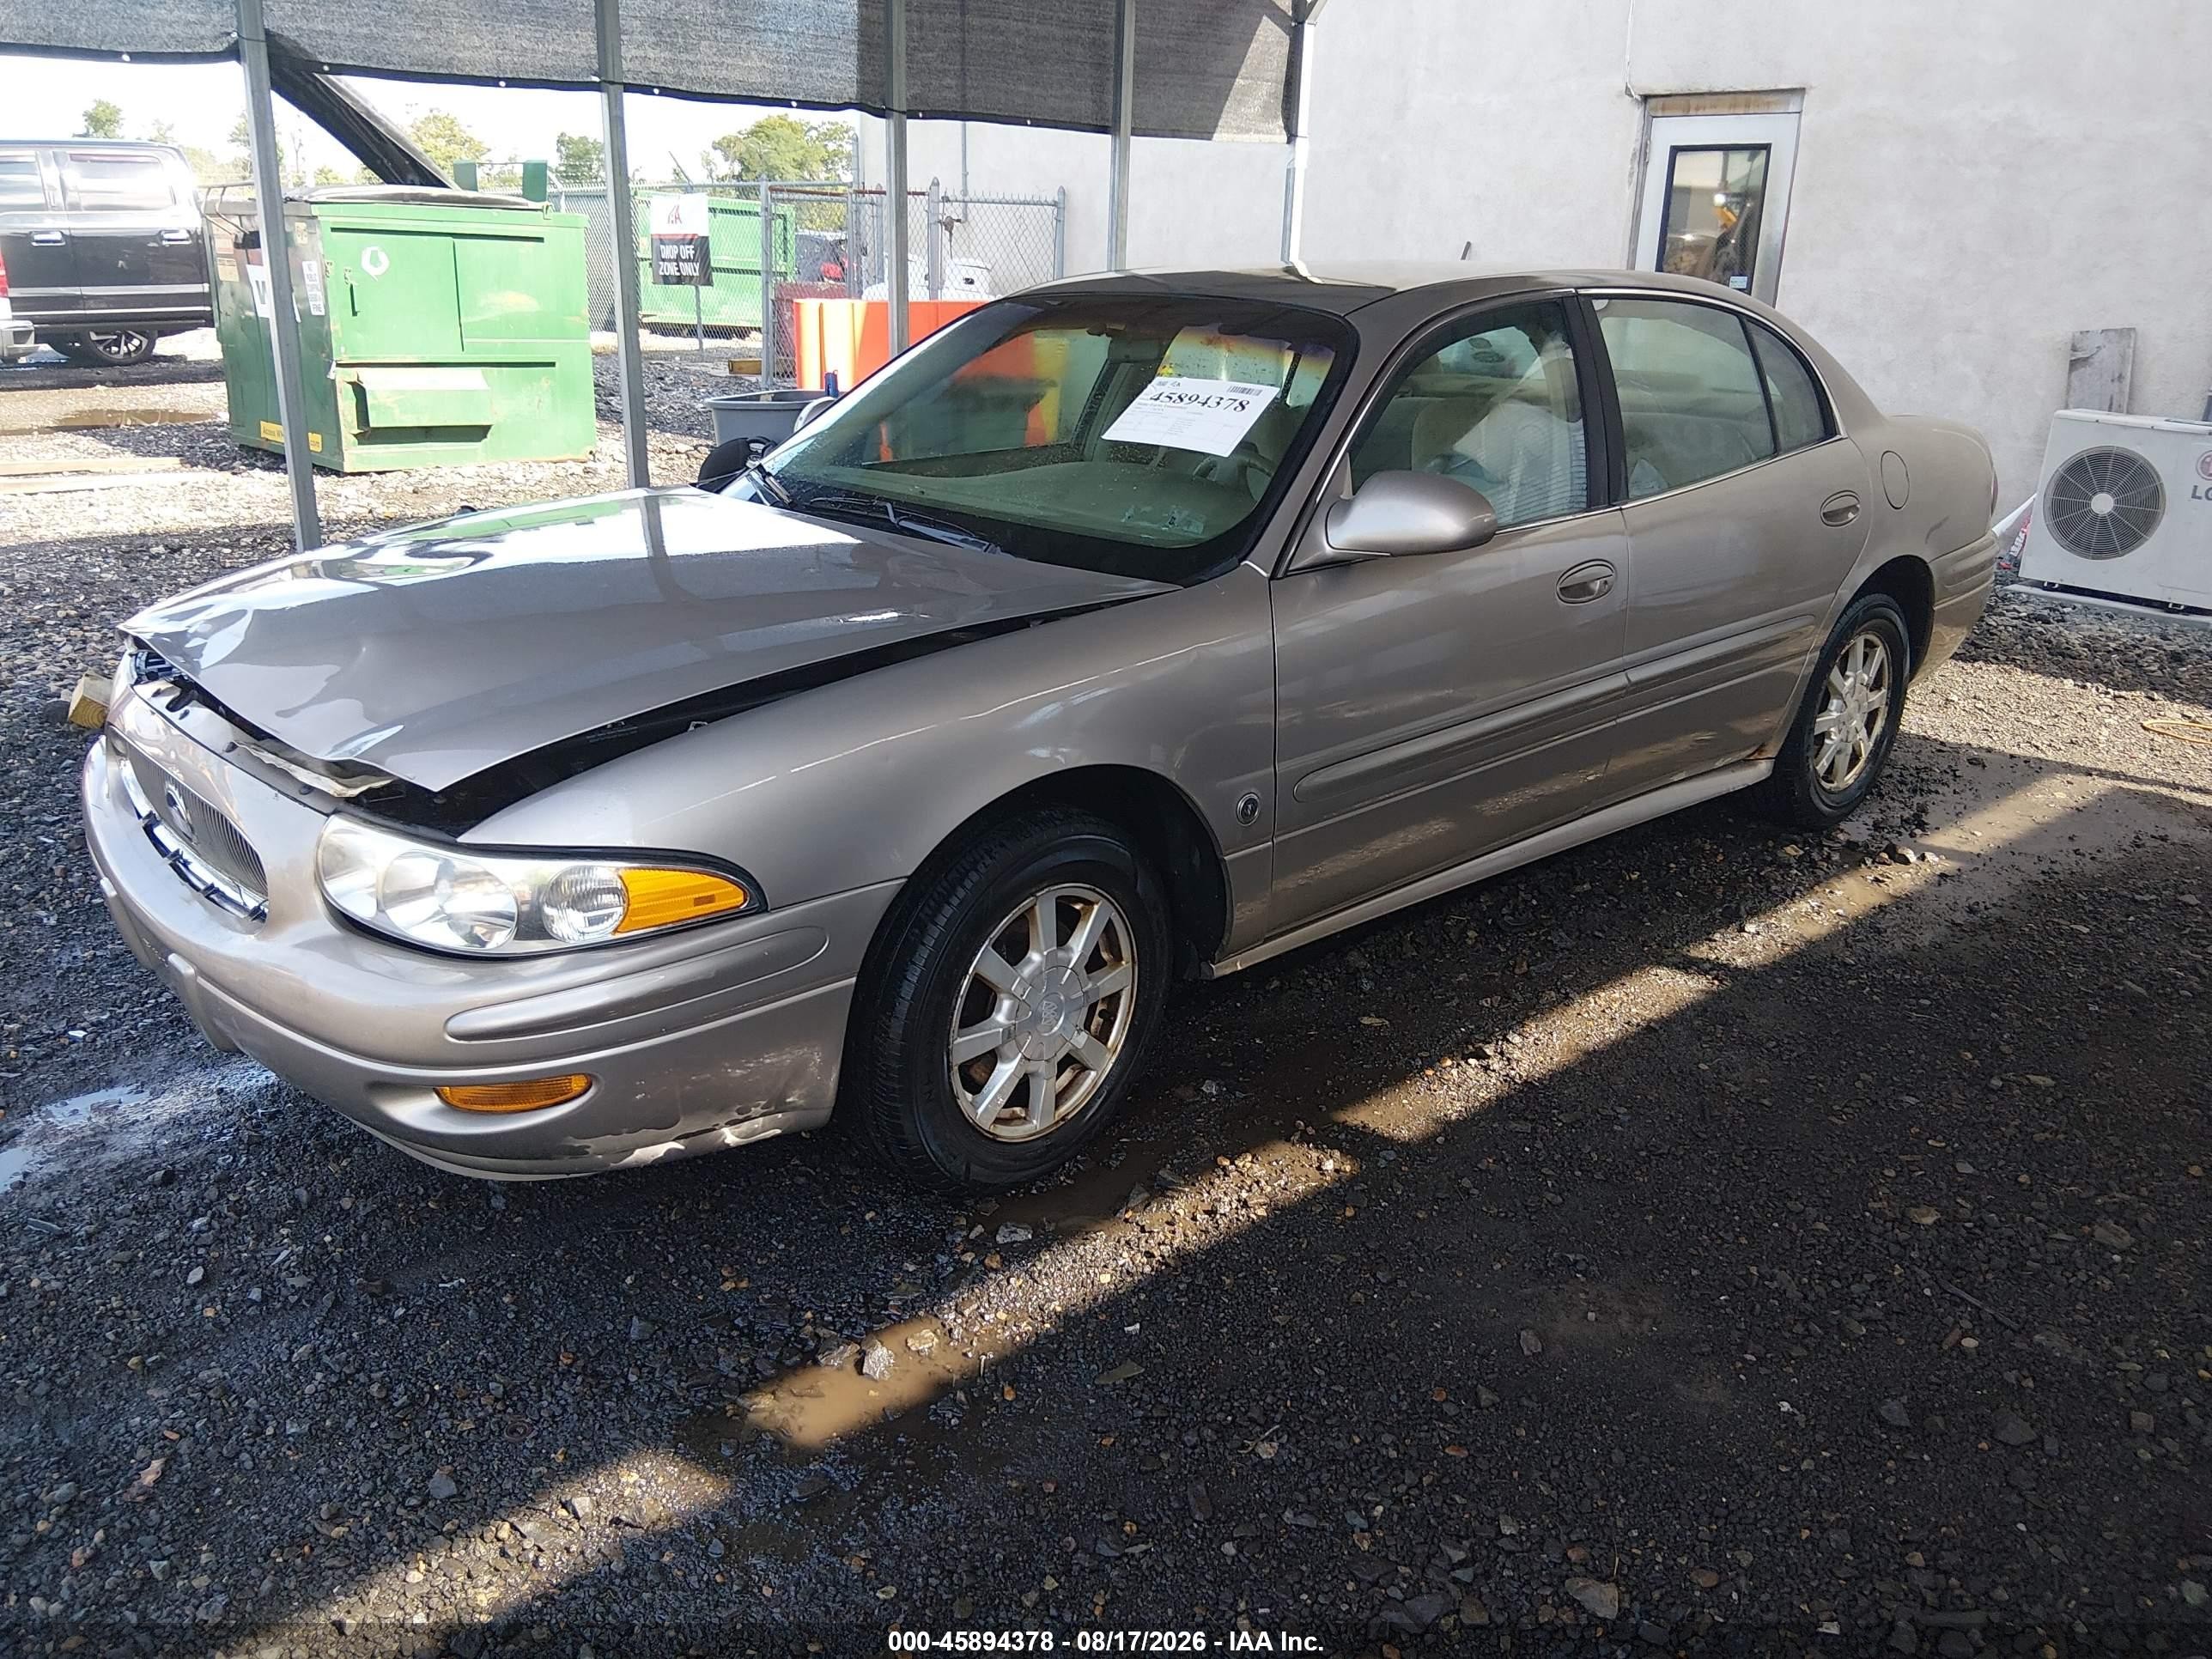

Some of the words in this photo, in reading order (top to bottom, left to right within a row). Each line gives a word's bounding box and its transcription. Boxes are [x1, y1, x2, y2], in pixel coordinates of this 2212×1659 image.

[659, 245, 679, 259] DROP
[679, 245, 696, 260] OFF
[659, 262, 680, 276] ZONE
[678, 262, 700, 276] ONLY
[1150, 392, 1250, 413] 45894378
